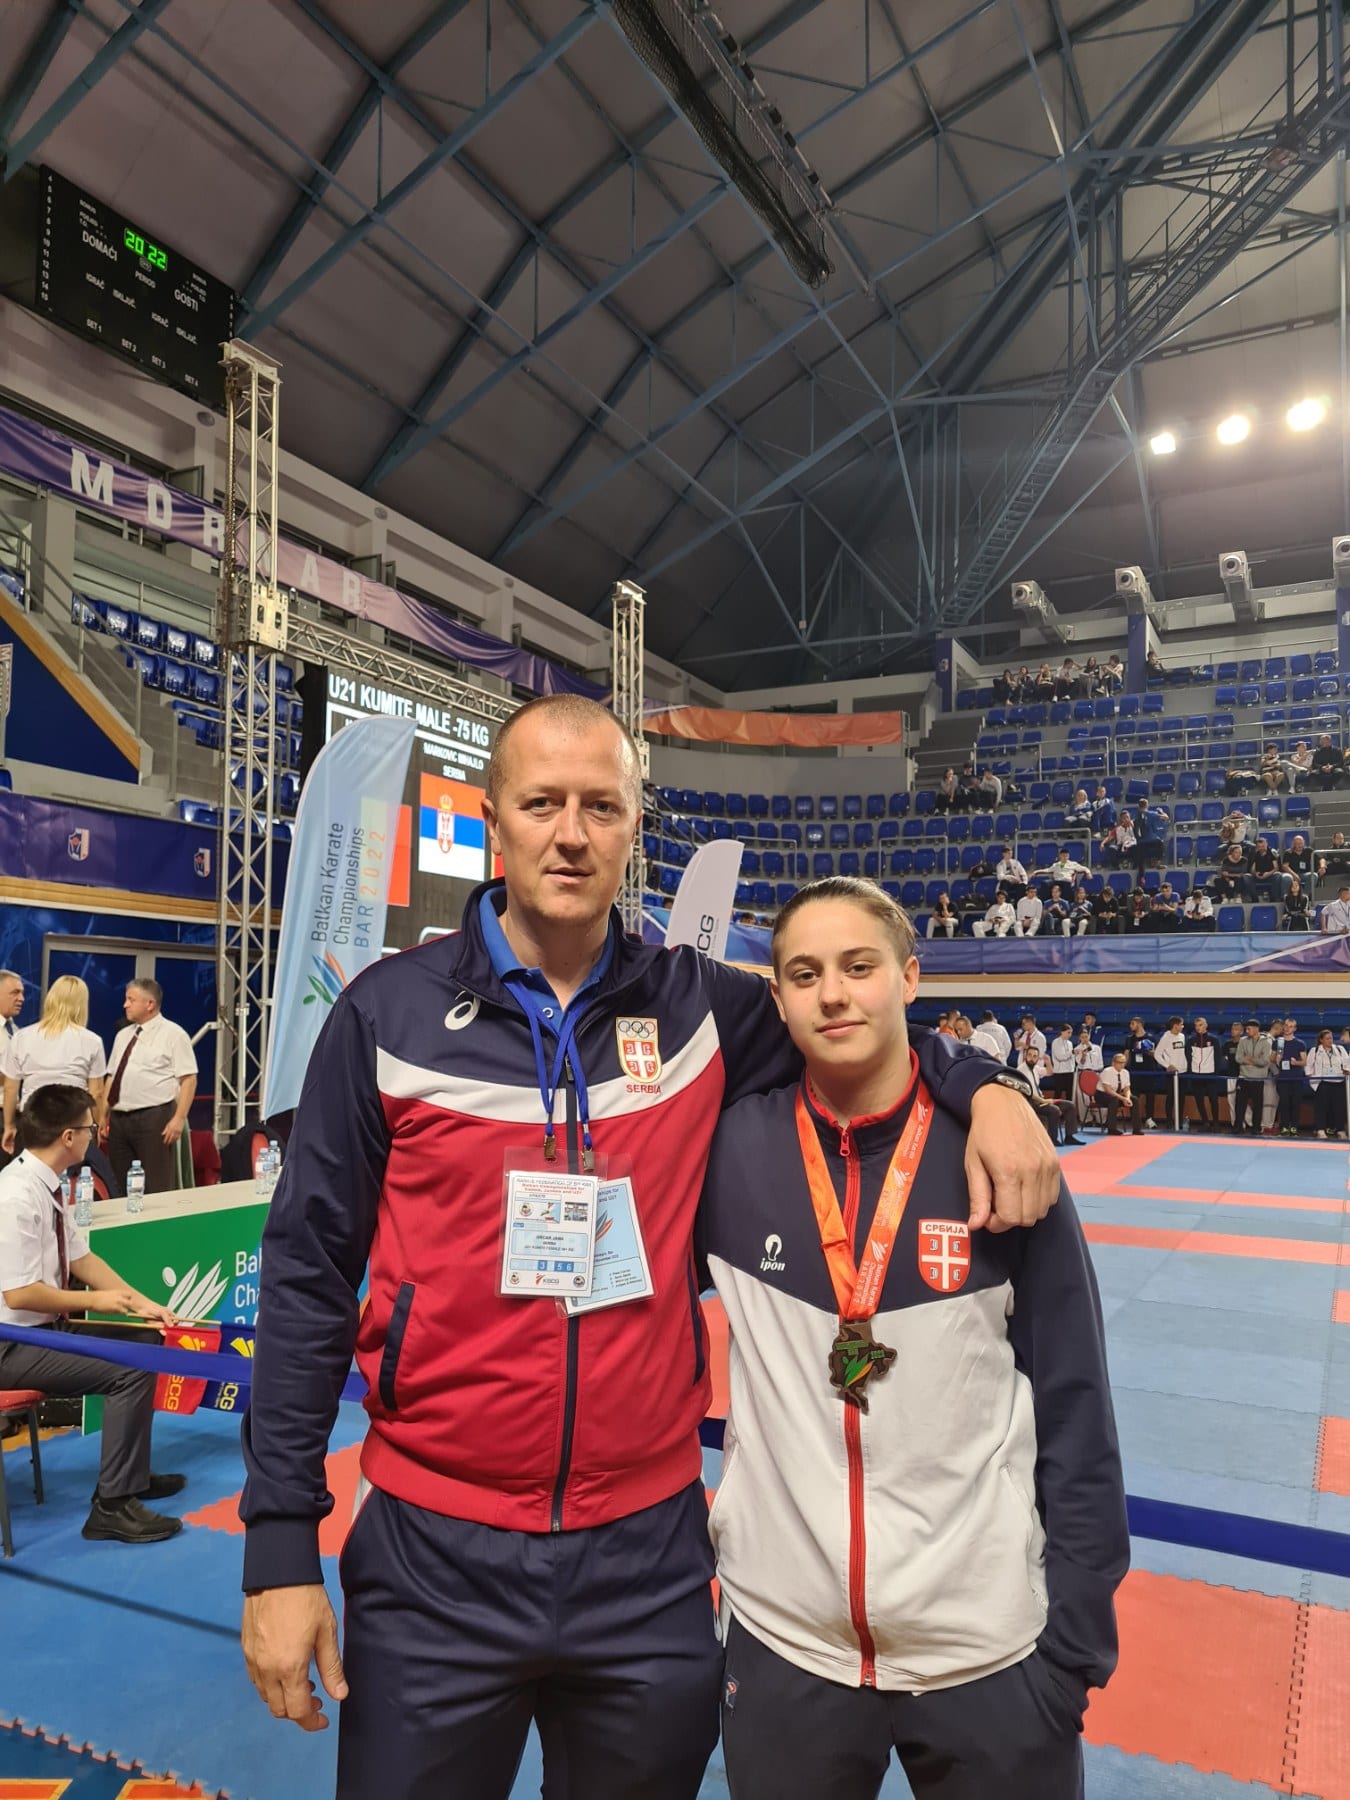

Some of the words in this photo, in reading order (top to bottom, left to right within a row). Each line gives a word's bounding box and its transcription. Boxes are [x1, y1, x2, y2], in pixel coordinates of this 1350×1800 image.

[174, 288, 199, 312] GOSTI
[328, 673, 356, 704] U21
[360, 684, 414, 719] KUMITE
[416, 703, 451, 735] MALE
[453, 717, 470, 741] -75
[471, 722, 489, 747] KG
[442, 764, 467, 781] SERBIA
[320, 822, 344, 879] Karate
[359, 831, 386, 897] 2022
[333, 828, 366, 945] Championships
[311, 884, 334, 943] Balkan
[354, 905, 374, 948] BAR
[697, 914, 714, 957] CG
[626, 1084, 662, 1095] SERBIA
[925, 1223, 966, 1234] СРБИЈА
[760, 1257, 786, 1271] ipon
[219, 1382, 240, 1411] CG
